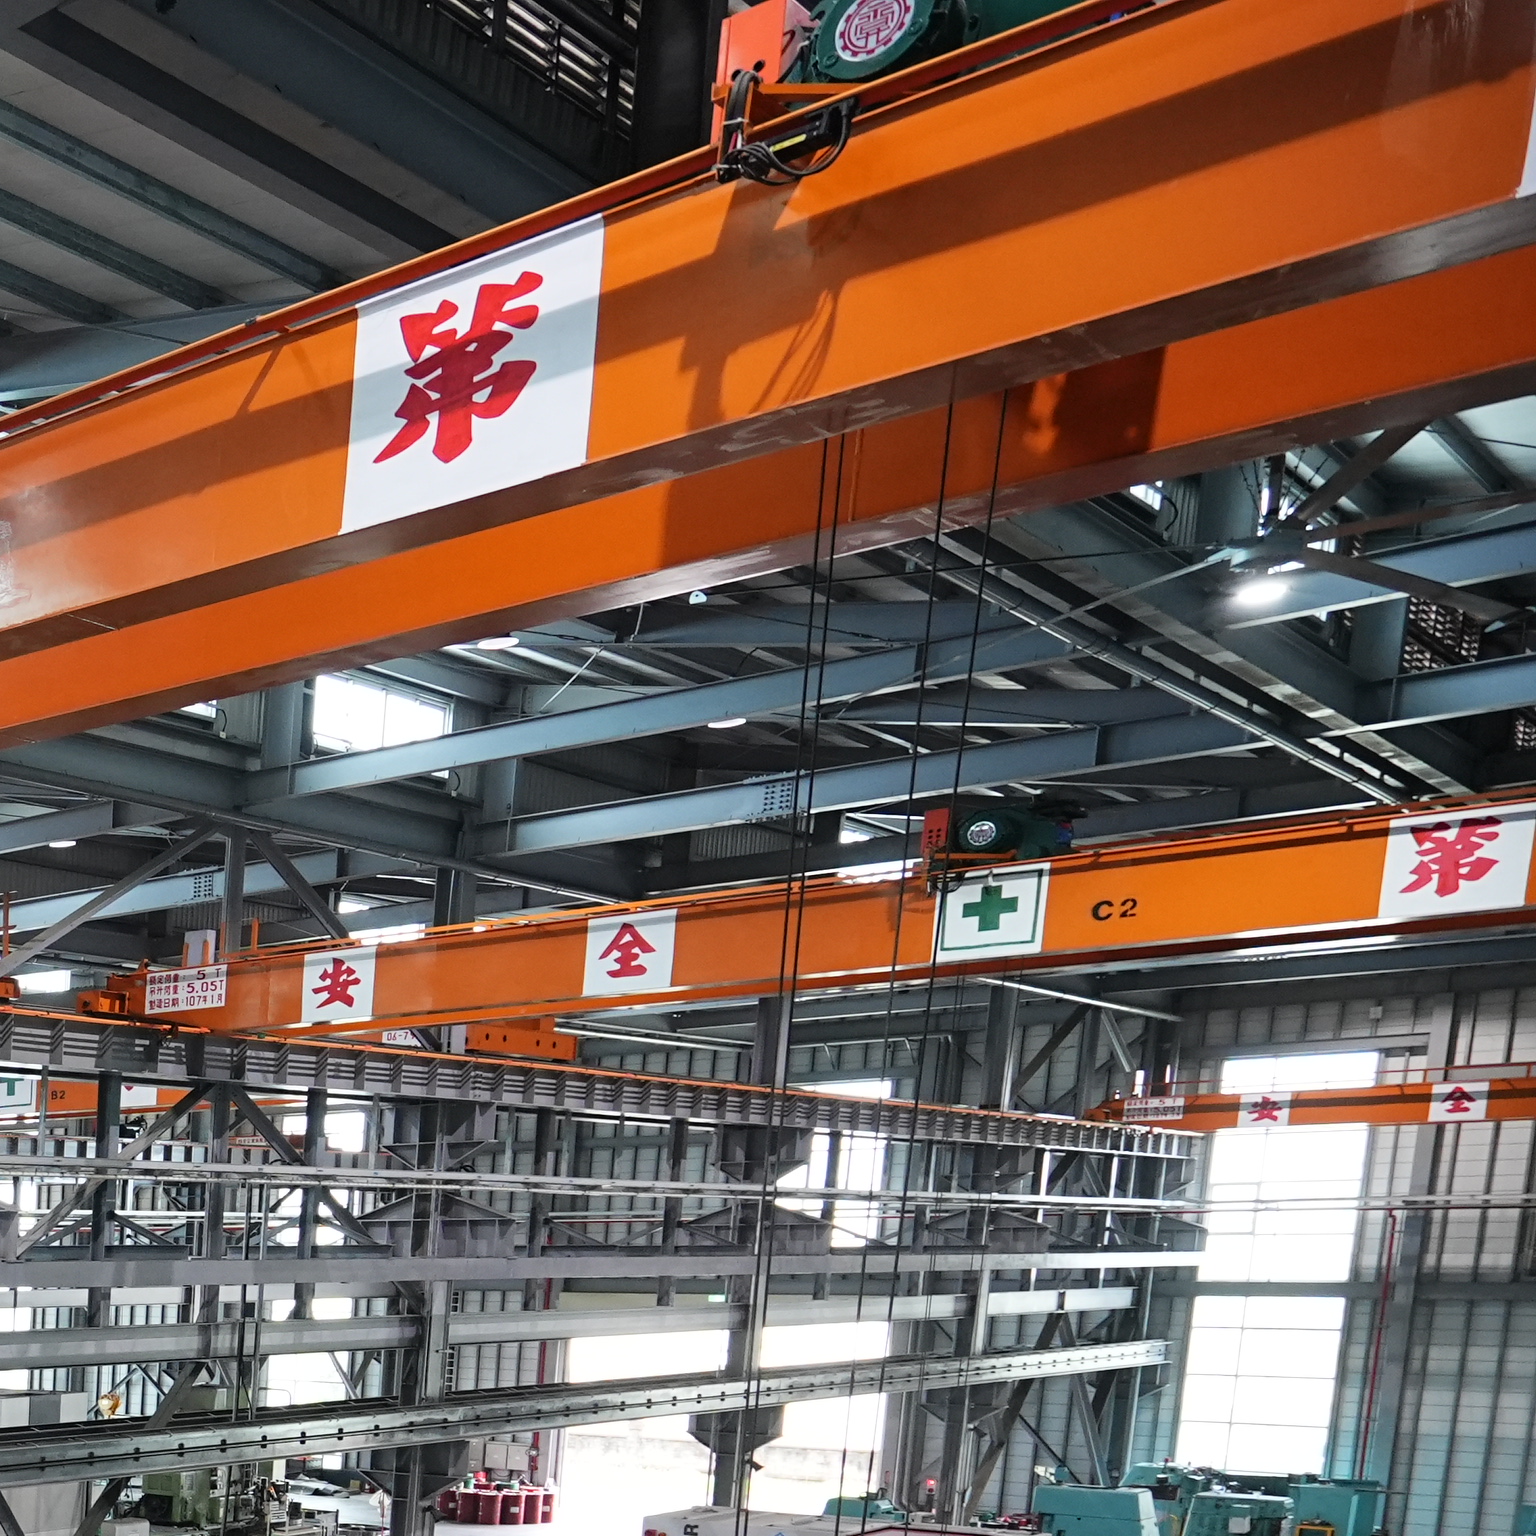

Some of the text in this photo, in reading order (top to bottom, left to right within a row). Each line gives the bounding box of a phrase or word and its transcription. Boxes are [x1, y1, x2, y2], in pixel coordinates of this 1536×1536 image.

[373, 270, 545, 465] 第
[1400, 816, 1504, 899] 第
[1091, 897, 1138, 922] C2
[600, 922, 658, 979] 全
[196, 969, 206, 981] 5
[215, 967, 222, 978] T
[312, 957, 362, 1009] 安
[50, 1090, 66, 1100] B2
[1247, 1095, 1283, 1122] 安
[1441, 1086, 1476, 1114] 全
